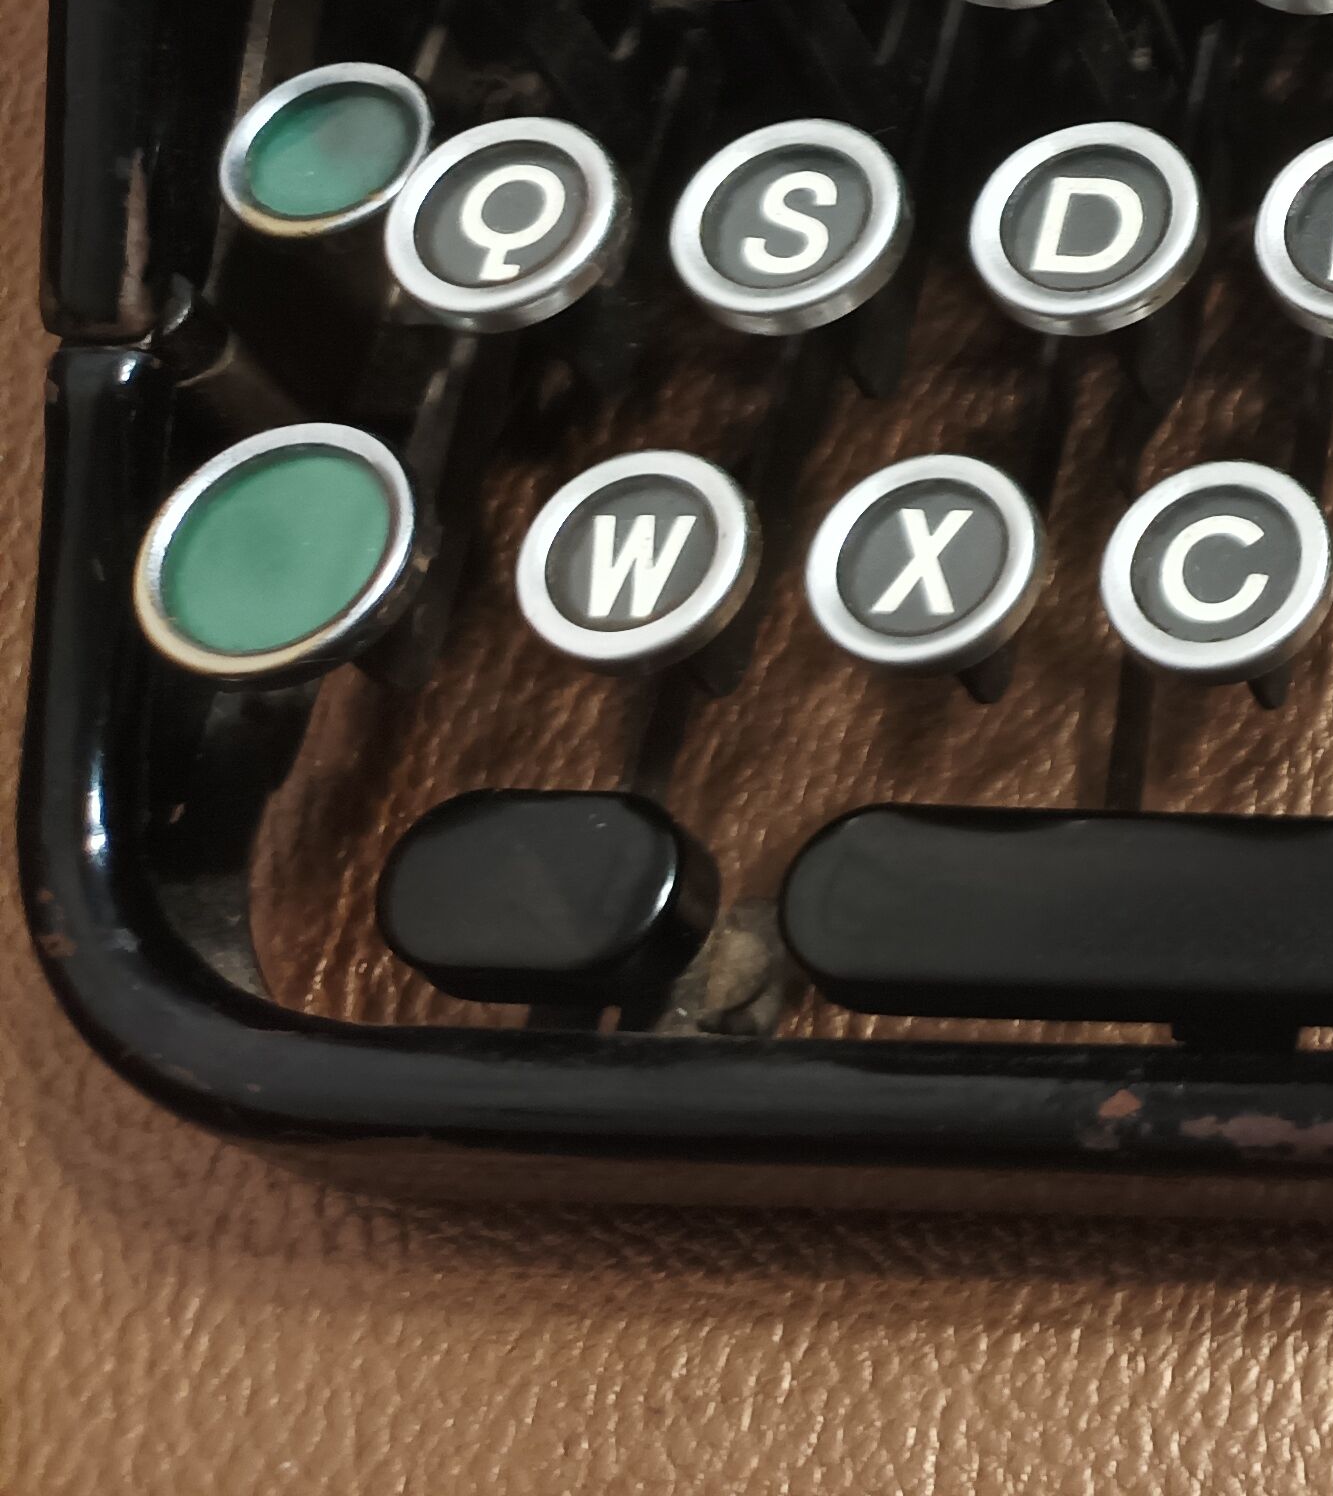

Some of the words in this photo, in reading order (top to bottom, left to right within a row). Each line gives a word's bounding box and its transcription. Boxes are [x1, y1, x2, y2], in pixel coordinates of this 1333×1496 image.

[461, 165, 565, 280] Q
[744, 171, 837, 273] S
[1031, 177, 1143, 273] D
[588, 514, 696, 618] W
[872, 508, 973, 614] X
[1161, 514, 1268, 621] C
